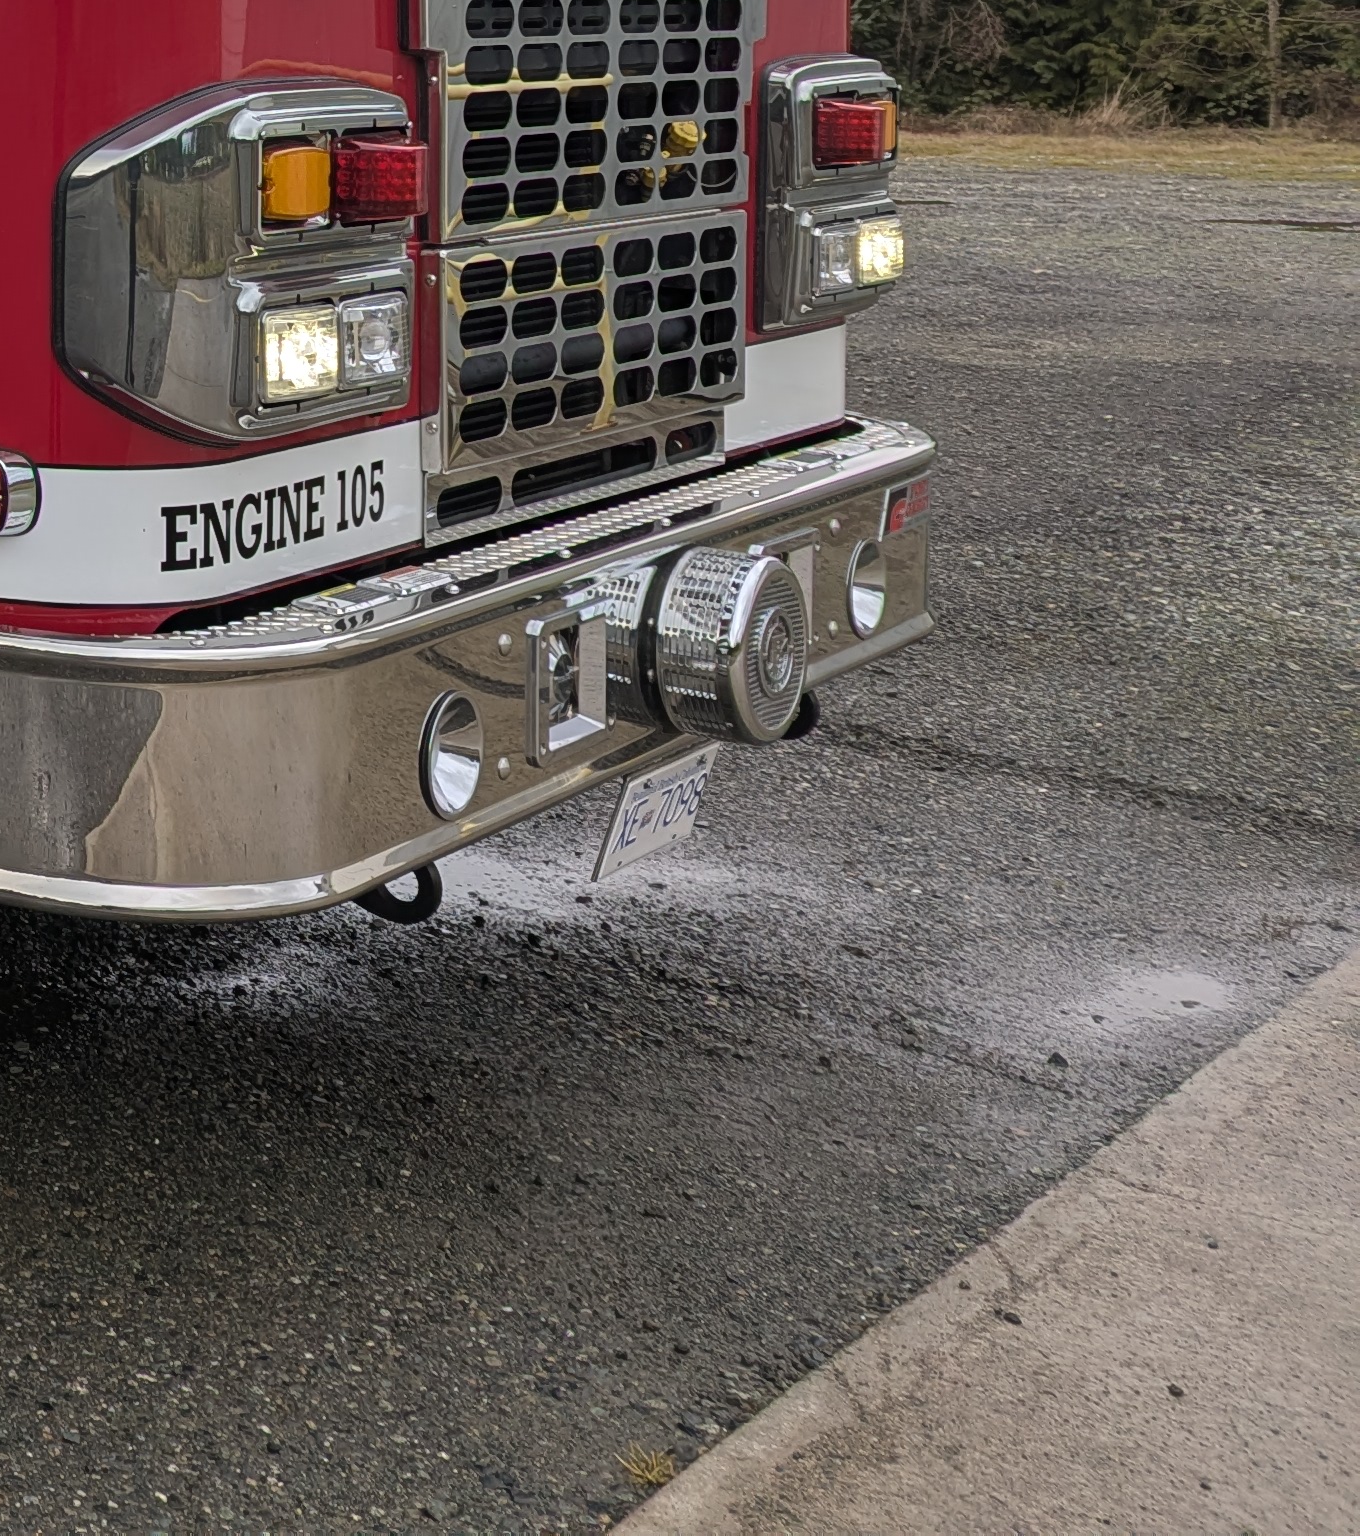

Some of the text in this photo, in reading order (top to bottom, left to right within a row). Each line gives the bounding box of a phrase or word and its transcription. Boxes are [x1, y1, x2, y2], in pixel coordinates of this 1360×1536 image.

[160, 459, 385, 573] ENGINE 105
[611, 798, 649, 854] XE
[651, 772, 708, 834] 7098
